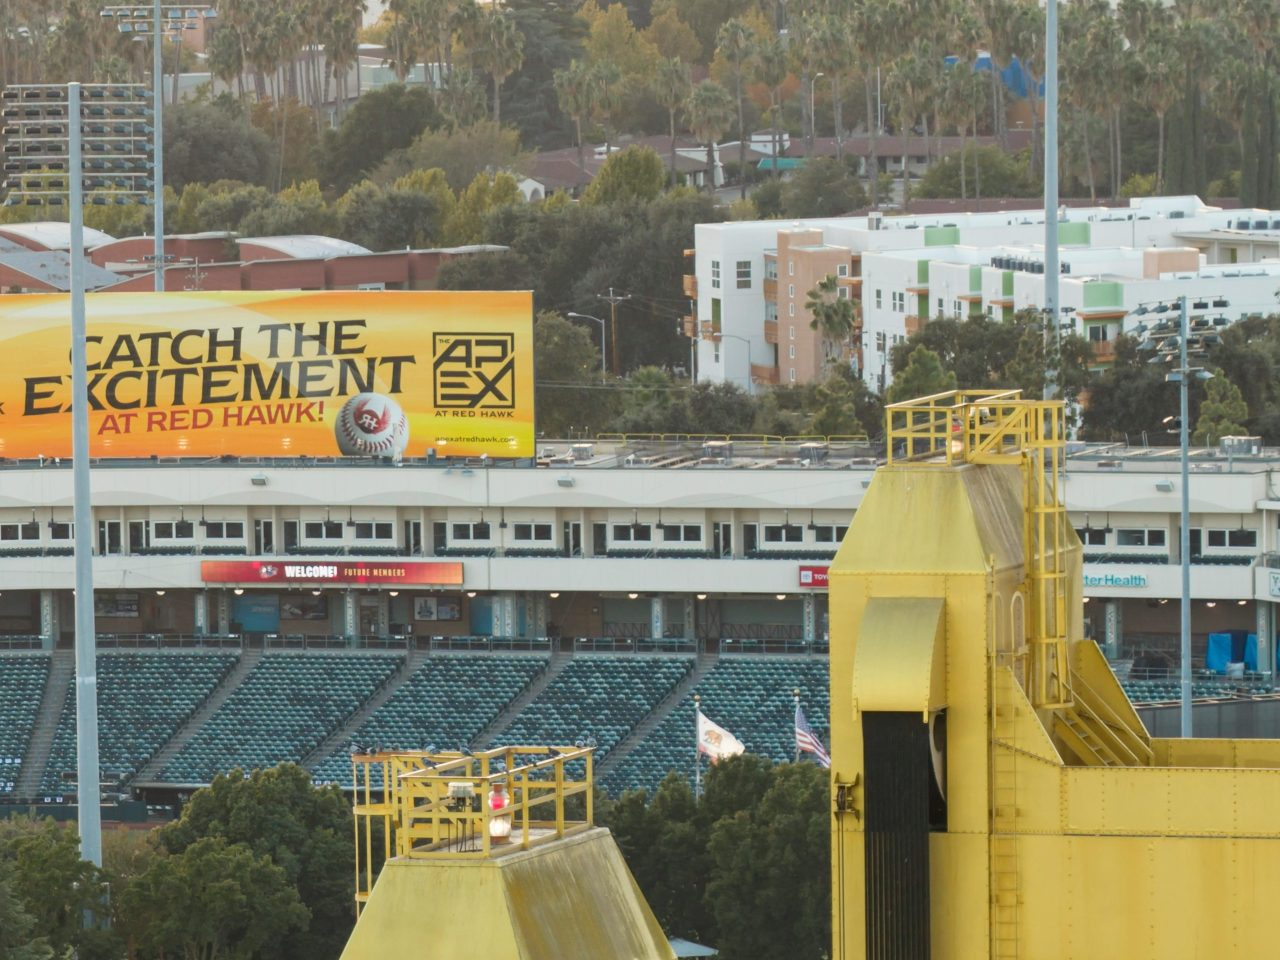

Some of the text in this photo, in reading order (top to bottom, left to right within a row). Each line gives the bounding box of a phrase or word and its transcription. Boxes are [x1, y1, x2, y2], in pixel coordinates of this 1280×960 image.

[69, 319, 368, 371] CATCH THE
[22, 355, 417, 417] EXCITEMENT
[97, 400, 325, 436] AT RED HAWK!
[435, 410, 514, 418] AT RED HAWK
[285, 566, 337, 578] WELCOME!
[344, 568, 406, 577] FUTURE MEMBERS
[1104, 575, 1146, 586] Health
